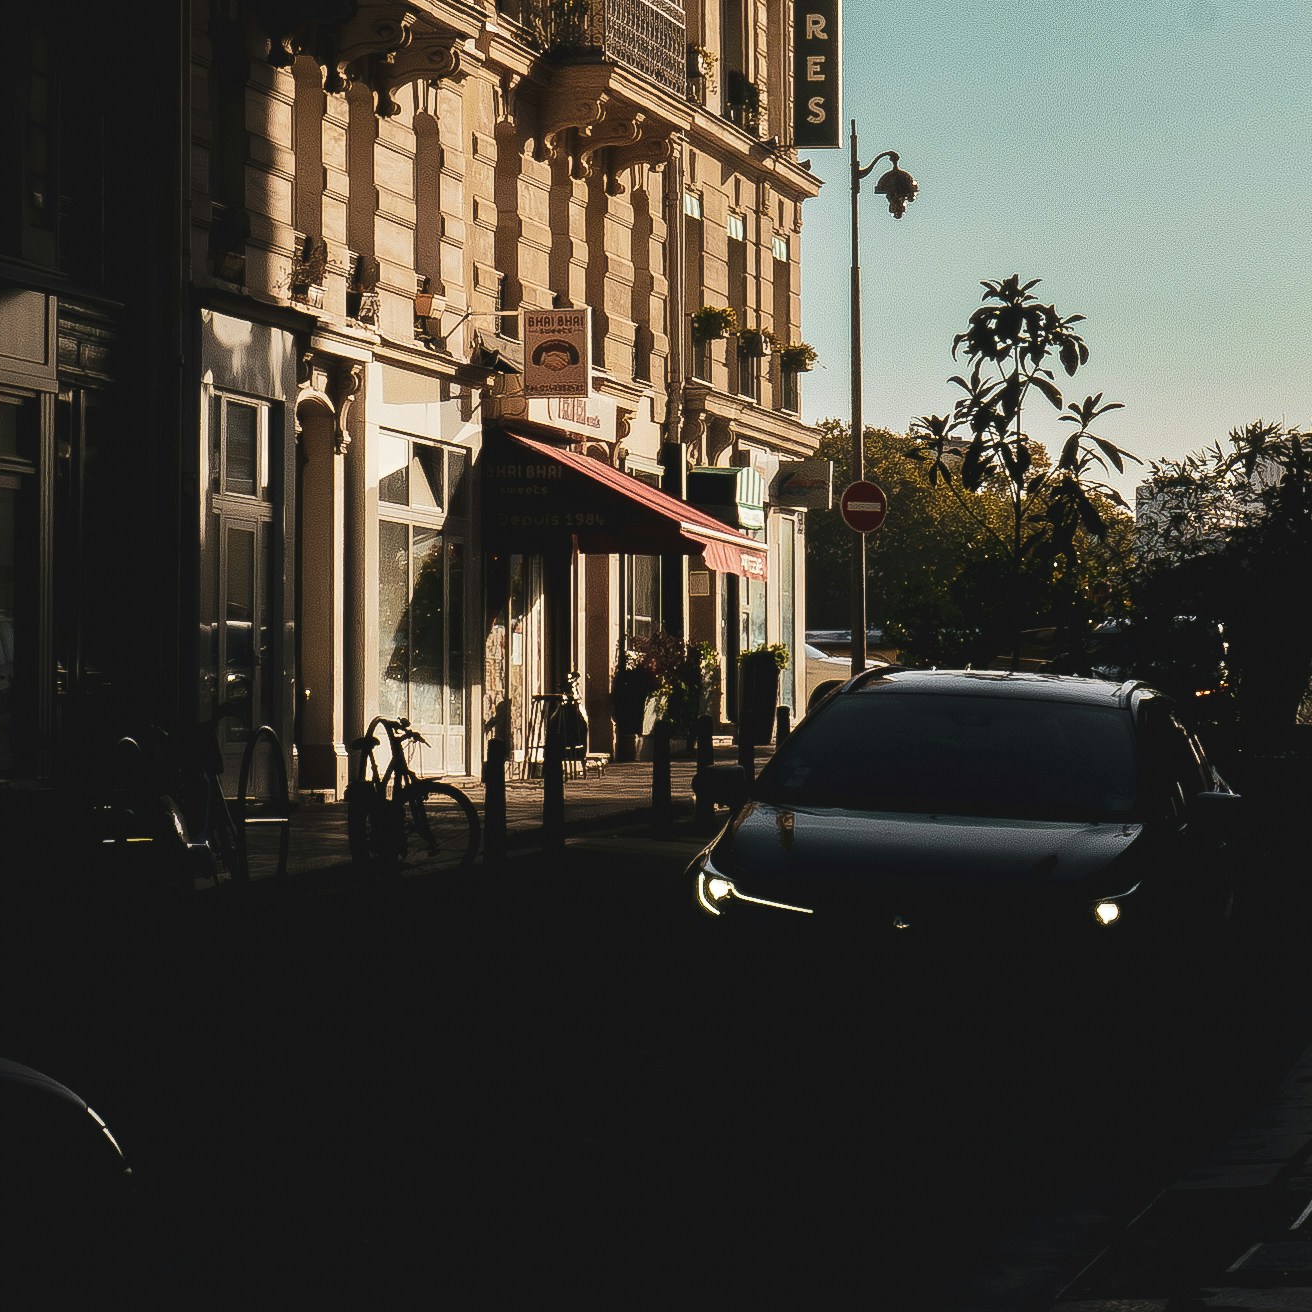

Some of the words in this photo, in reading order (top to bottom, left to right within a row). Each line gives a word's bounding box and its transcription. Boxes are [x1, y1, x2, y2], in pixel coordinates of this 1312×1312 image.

[528, 316, 555, 328] BHAI
[557, 315, 585, 327] BHAI
[486, 465, 522, 479] BHAI
[526, 465, 563, 479] BHAI
[498, 513, 560, 527] Depuis
[565, 513, 606, 526] 1984
